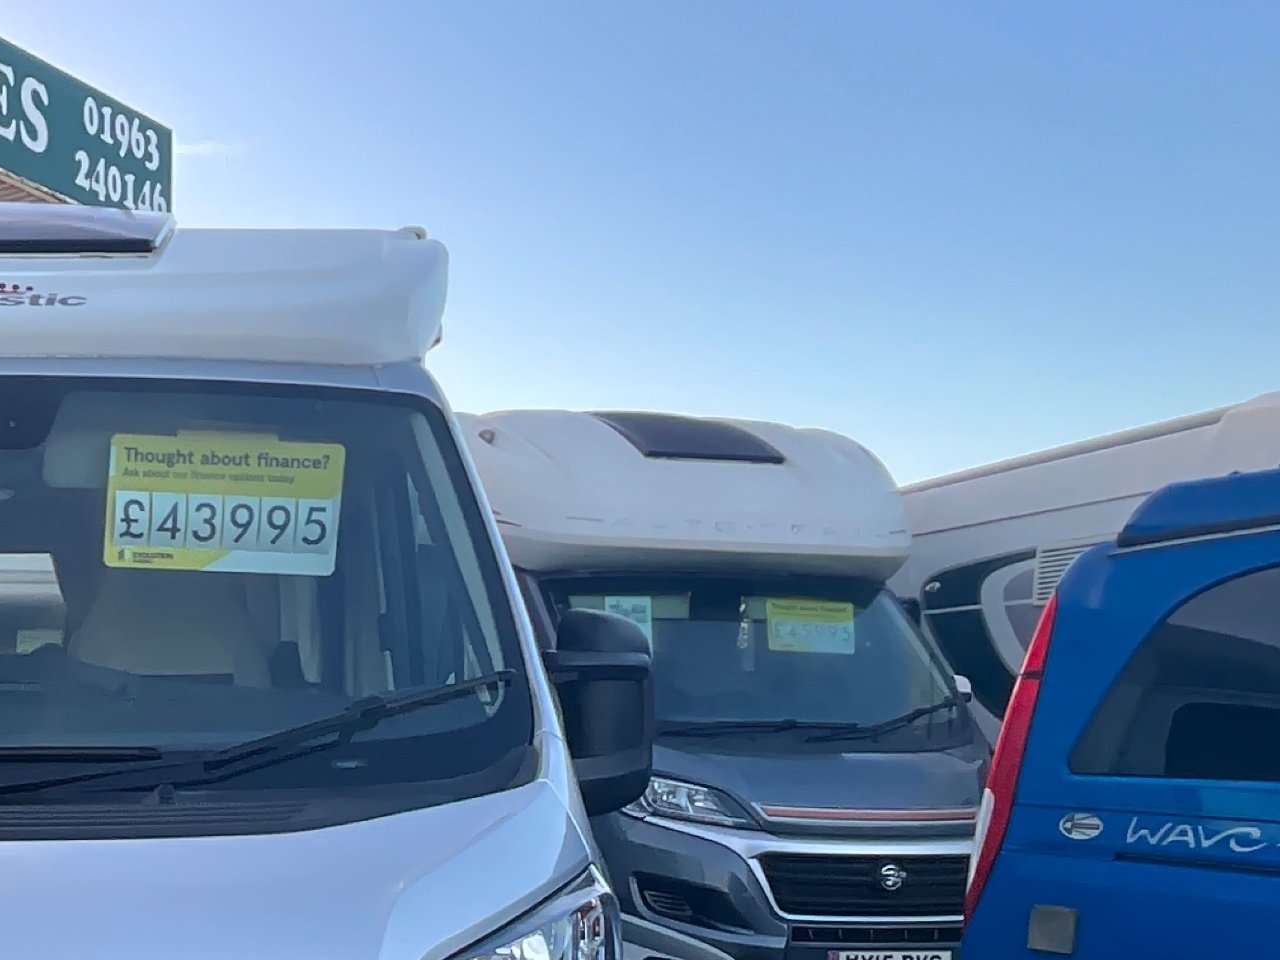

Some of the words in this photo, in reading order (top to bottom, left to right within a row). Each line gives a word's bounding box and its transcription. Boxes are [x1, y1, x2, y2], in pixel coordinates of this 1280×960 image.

[83, 96, 159, 171] 01963
[124, 446, 195, 468] Thought
[200, 450, 250, 467] about
[257, 451, 330, 470] finance?
[119, 499, 327, 546] £43995
